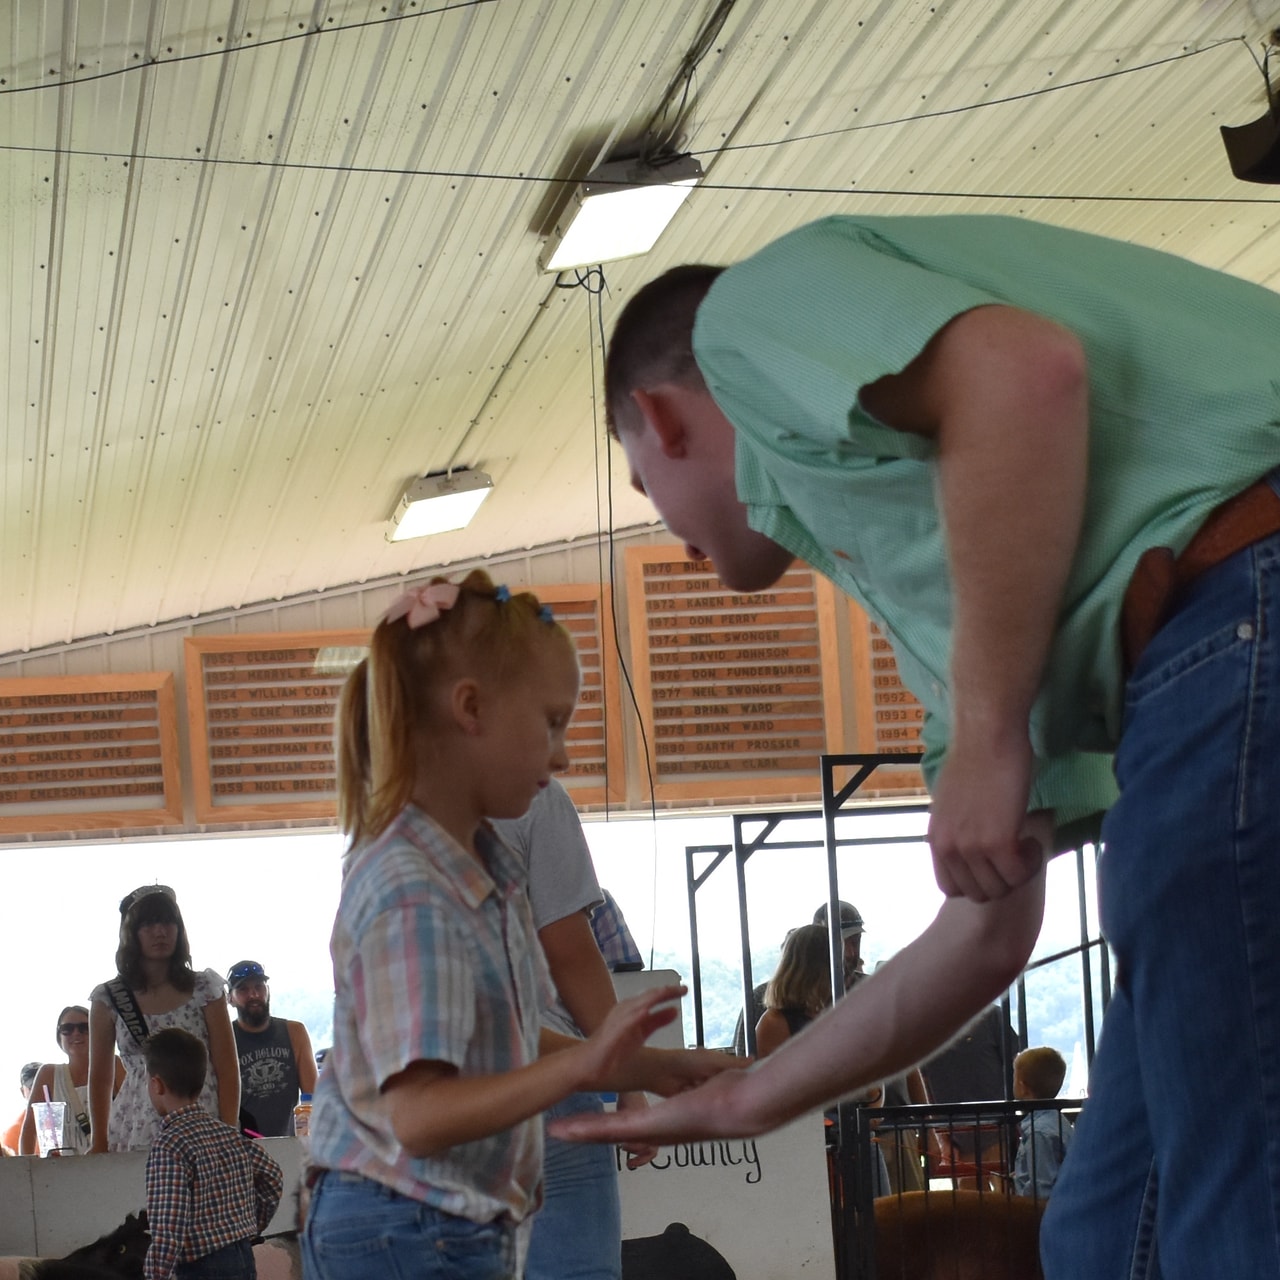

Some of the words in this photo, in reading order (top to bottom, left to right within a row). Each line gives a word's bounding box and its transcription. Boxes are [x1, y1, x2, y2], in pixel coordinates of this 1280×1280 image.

[683, 561, 708, 572] BILL
[687, 580, 709, 590] DON
[687, 596, 724, 608] KAREN
[732, 594, 776, 605] BLAZER
[689, 614, 715, 625] DON
[721, 612, 759, 623] PERRY
[689, 633, 715, 644] NEIL
[724, 631, 780, 641] SWONGER
[691, 650, 726, 661] DAVID
[735, 647, 789, 659] JOHNSON
[693, 668, 715, 678] DON
[727, 665, 811, 676] FUNDERBURGH
[208, 690, 237, 700] 1954
[249, 688, 297, 698] WILLIAM
[693, 685, 719, 696] NEIL
[727, 683, 783, 695] SWONGER
[21, 694, 77, 706] EMERSON
[82, 690, 157, 703] LITTLEJOHN
[879, 693, 905, 703] 1992
[694, 703, 728, 714] BRIAN
[741, 701, 772, 712] WARD
[25, 711, 64, 724] JAMES
[880, 710, 907, 720] 1993
[255, 725, 283, 735] JOHN
[292, 723, 327, 733] WHITE
[696, 722, 730, 733] BRIAN
[743, 719, 774, 730] WARD
[26, 732, 70, 744] MELVIN
[881, 729, 908, 739] 1994
[252, 743, 307, 753] SHERMAN
[697, 740, 734, 751] GARTH
[747, 737, 800, 749] PROSSER
[29, 750, 81, 762] CHARLES
[93, 748, 132, 758] GATES
[28, 768, 83, 780] EMERSON
[88, 764, 162, 777] LITTLEJOHN
[255, 762, 302, 772] WILLIAM
[30, 788, 85, 800] EMERSON
[90, 782, 164, 796] LITTLEJOHN
[256, 781, 284, 791] NOEL
[255, 1047, 290, 1059] HOLLOW
